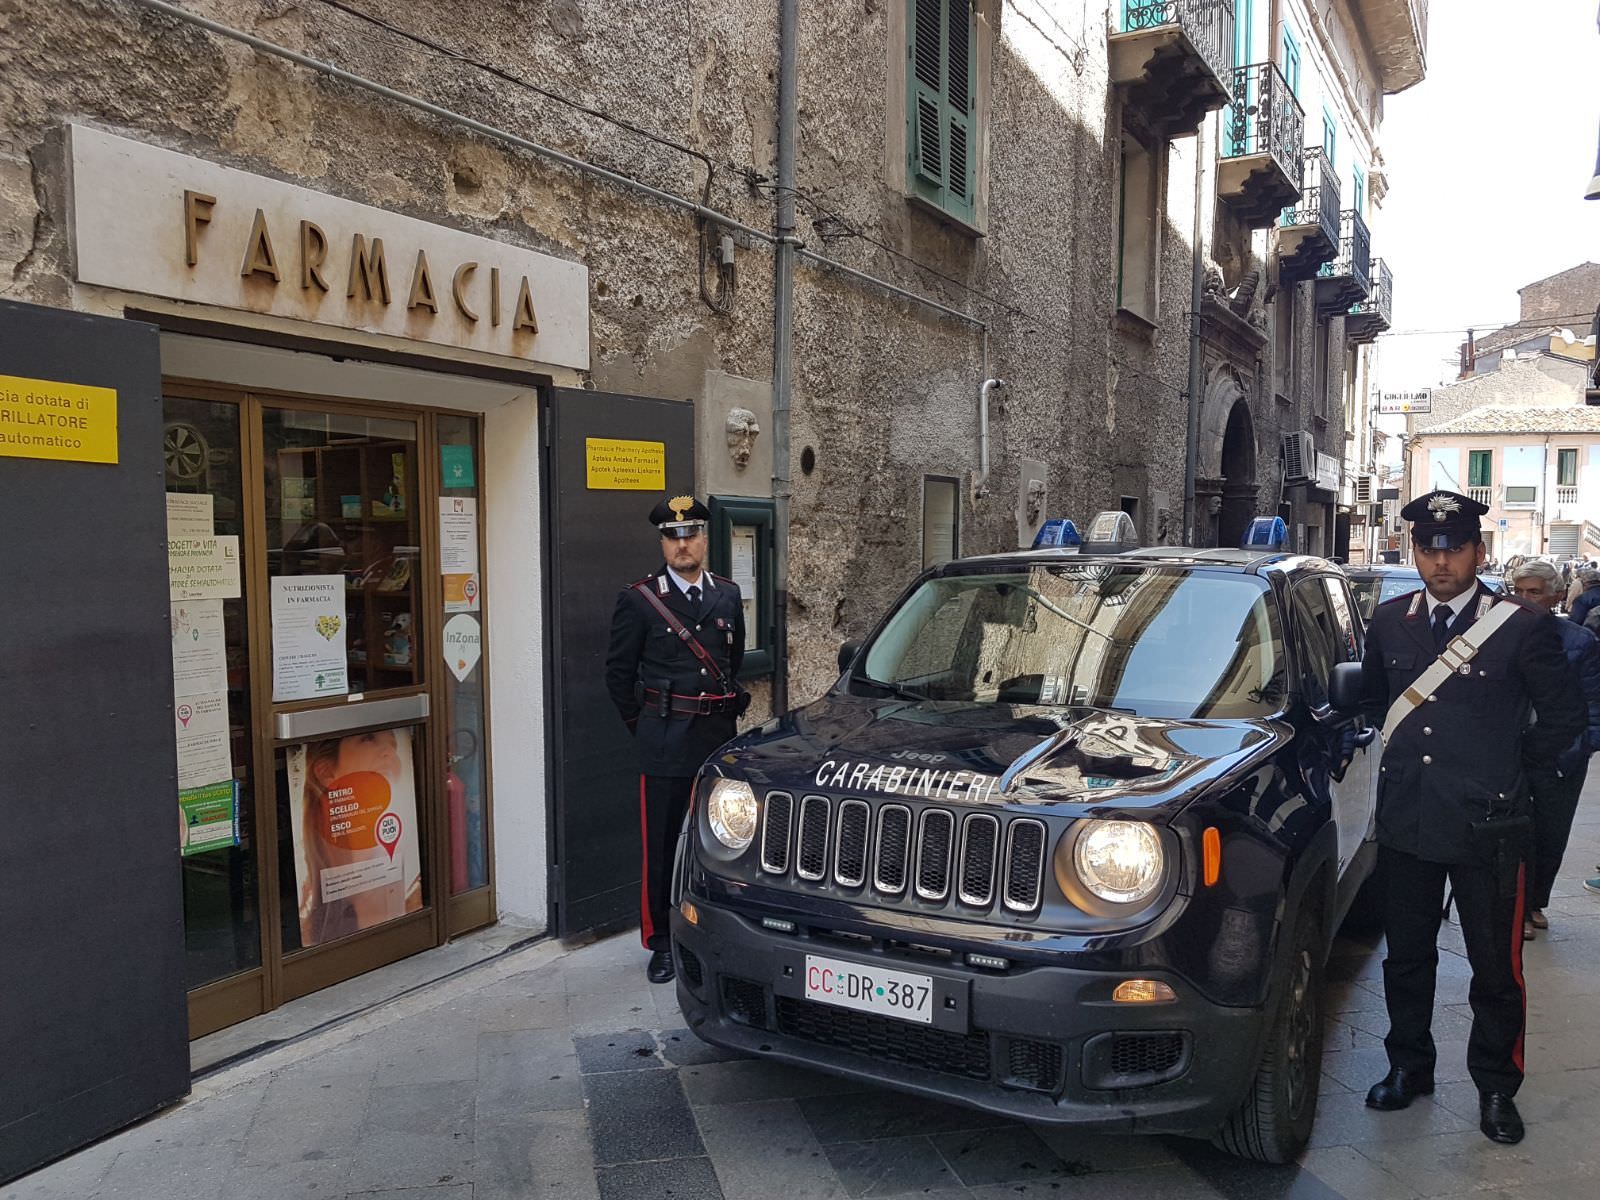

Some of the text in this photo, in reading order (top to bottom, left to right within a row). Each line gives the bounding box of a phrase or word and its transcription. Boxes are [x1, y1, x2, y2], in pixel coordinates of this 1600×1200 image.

[184, 189, 539, 334] FARMACIA
[26, 392, 71, 408] dotata
[77, 398, 89, 410] di
[1, 409, 88, 429] RILLATORE
[0, 432, 82, 448] automatico
[282, 584, 335, 592] NUTRIZIONISTA
[296, 596, 331, 604] FARMACIA
[446, 631, 480, 644] InZona
[890, 750, 947, 764] Jeep
[815, 760, 998, 802] CARABINIERI
[328, 787, 353, 799] ENTRO
[329, 802, 359, 816] SCELGO
[331, 821, 351, 833] ESCO
[382, 818, 394, 828] QUI
[808, 966, 929, 1011] CC DR 387
